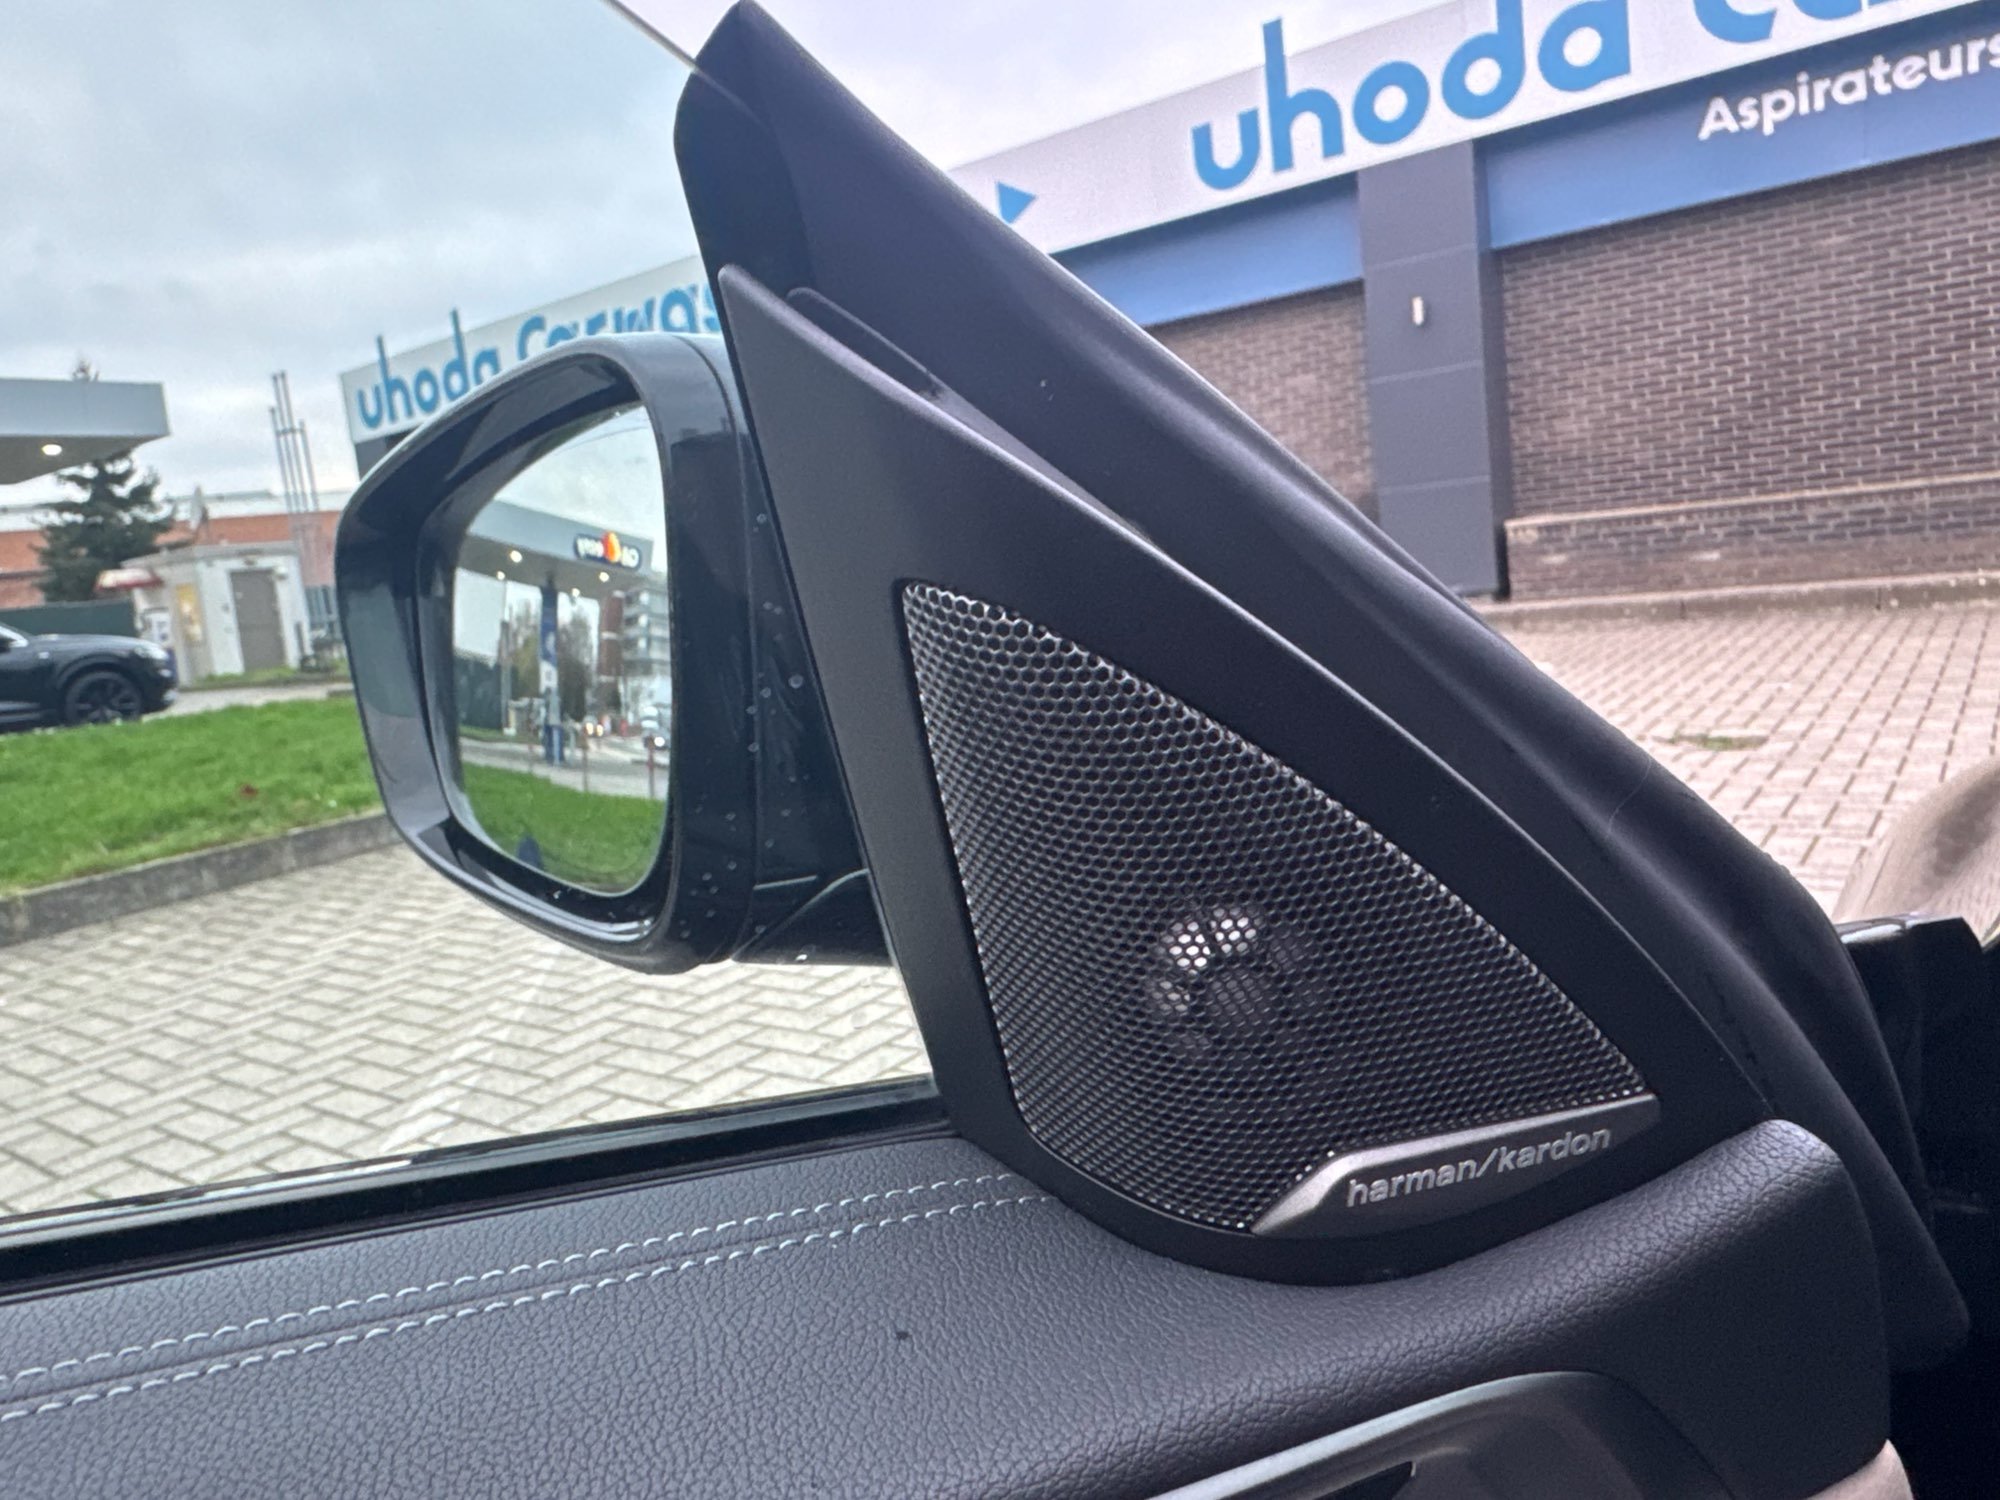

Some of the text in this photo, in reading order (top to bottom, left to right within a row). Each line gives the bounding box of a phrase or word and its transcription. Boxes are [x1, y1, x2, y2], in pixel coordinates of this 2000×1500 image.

[1192, 0, 1629, 190] uhoda
[1698, 32, 2000, 140] Aspirateurs
[357, 309, 501, 428] uhoda
[1347, 1128, 1611, 1207] harman/kardon
